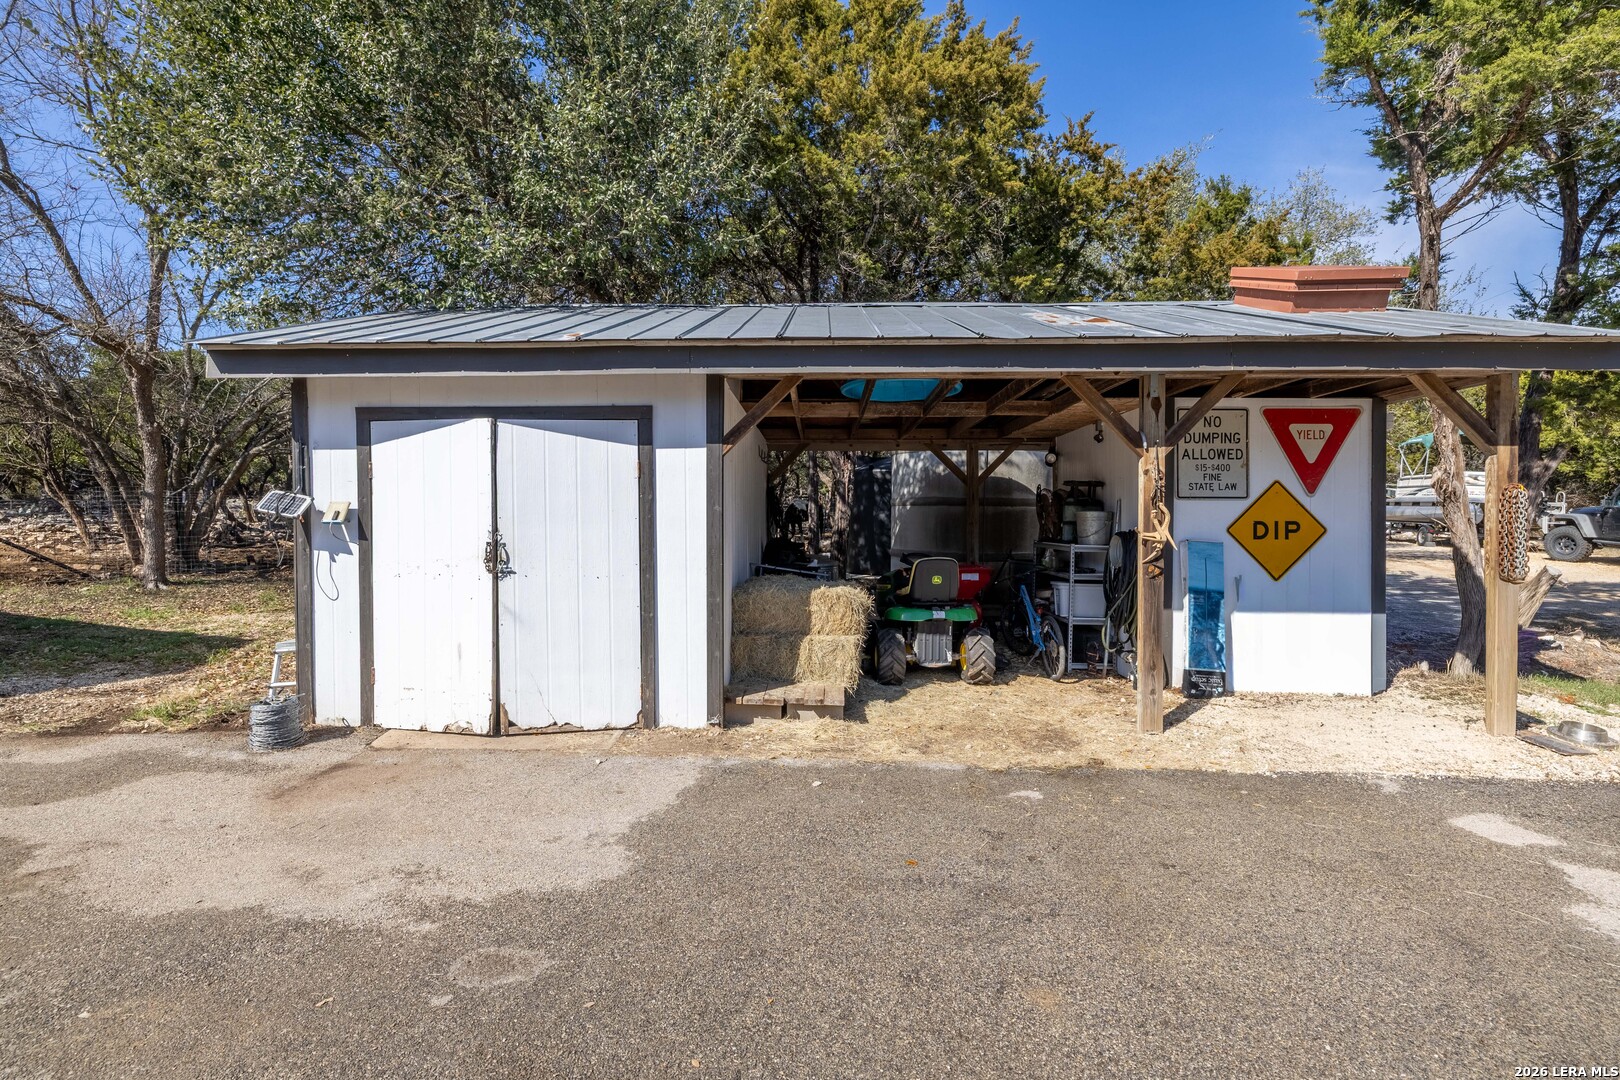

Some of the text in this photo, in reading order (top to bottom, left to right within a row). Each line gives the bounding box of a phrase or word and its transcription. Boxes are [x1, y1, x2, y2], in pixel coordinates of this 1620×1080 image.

[1203, 416, 1222, 428] NO
[1184, 432, 1241, 444] DUMPING
[1296, 429, 1325, 440] YIELD
[1181, 448, 1244, 460] ALLOWED
[1195, 463, 1231, 472] $15-$400
[1203, 473, 1222, 481] FINE
[1188, 482, 1237, 491] STATE LAW
[1253, 520, 1301, 540] DIP
